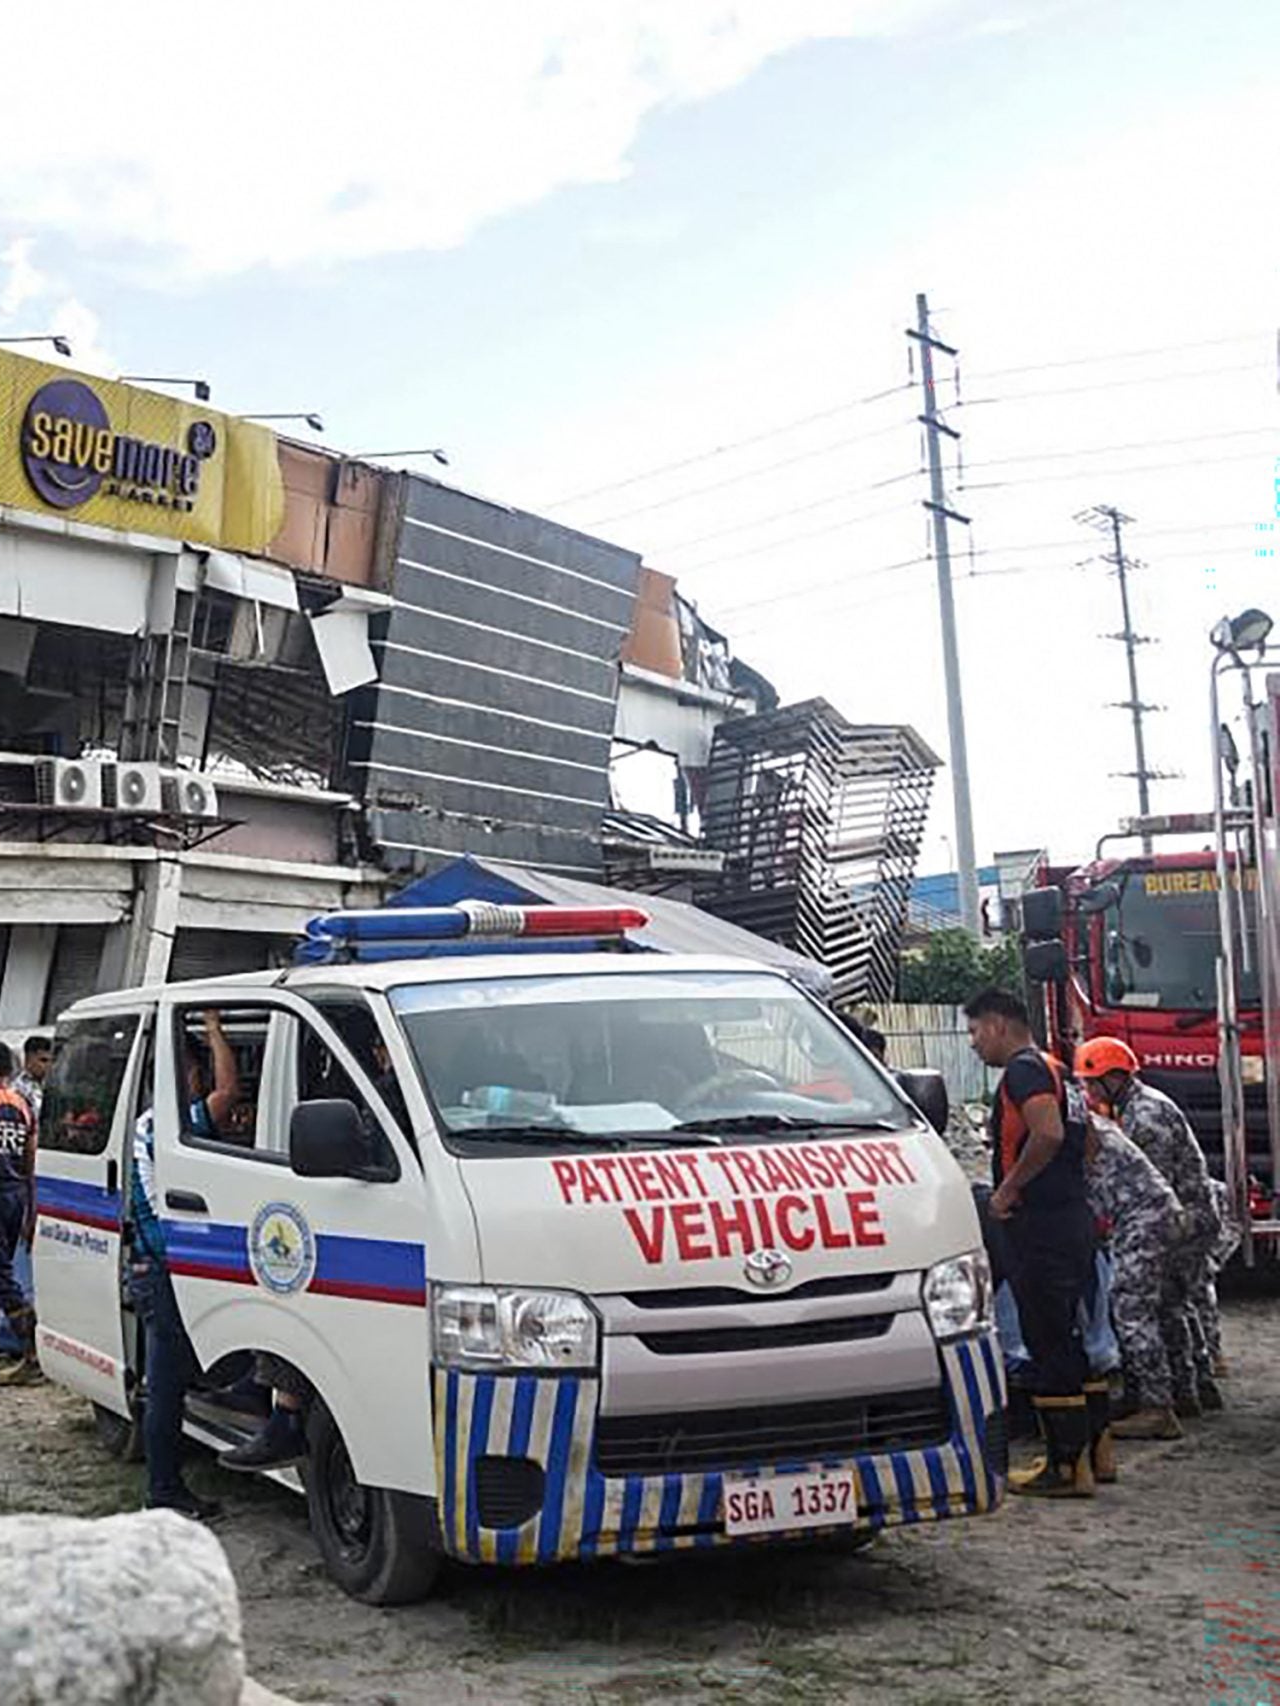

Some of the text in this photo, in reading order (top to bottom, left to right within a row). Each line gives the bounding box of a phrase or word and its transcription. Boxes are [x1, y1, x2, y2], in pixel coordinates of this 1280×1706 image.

[1143, 1053, 1216, 1066] HINO
[551, 1141, 918, 1204] PATIENT TRANSPORT
[623, 1191, 886, 1264] VEHICLE
[728, 1480, 851, 1523] SGA 1337
